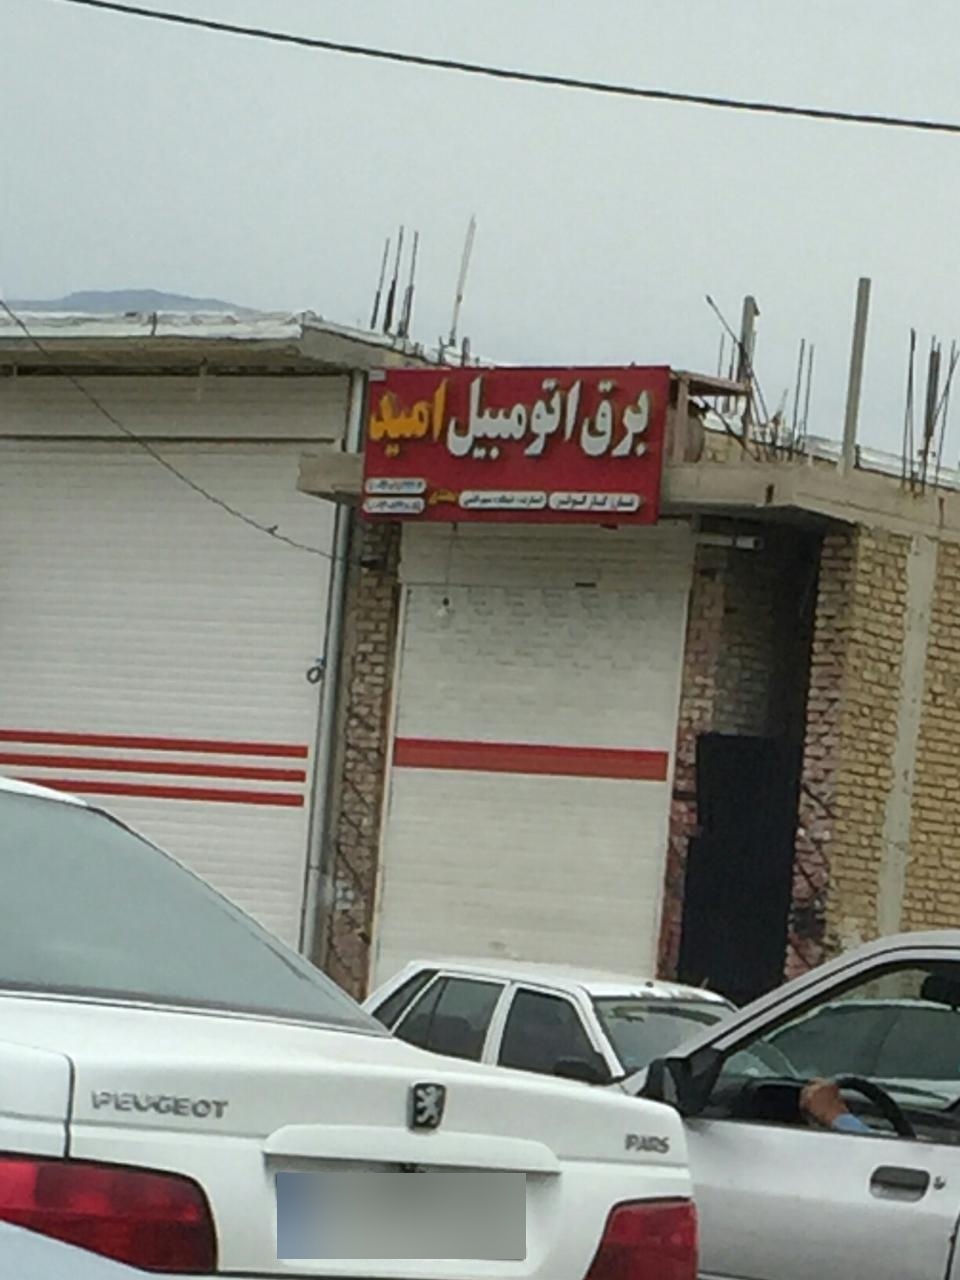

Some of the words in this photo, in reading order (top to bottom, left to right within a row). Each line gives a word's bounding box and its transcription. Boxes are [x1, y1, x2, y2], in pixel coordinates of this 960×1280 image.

[368, 376, 449, 456] امید
[446, 374, 582, 460] اتومبیل
[580, 377, 651, 457] برق
[91, 1089, 229, 1120] PEUGEOT
[625, 1132, 672, 1154] PARS
